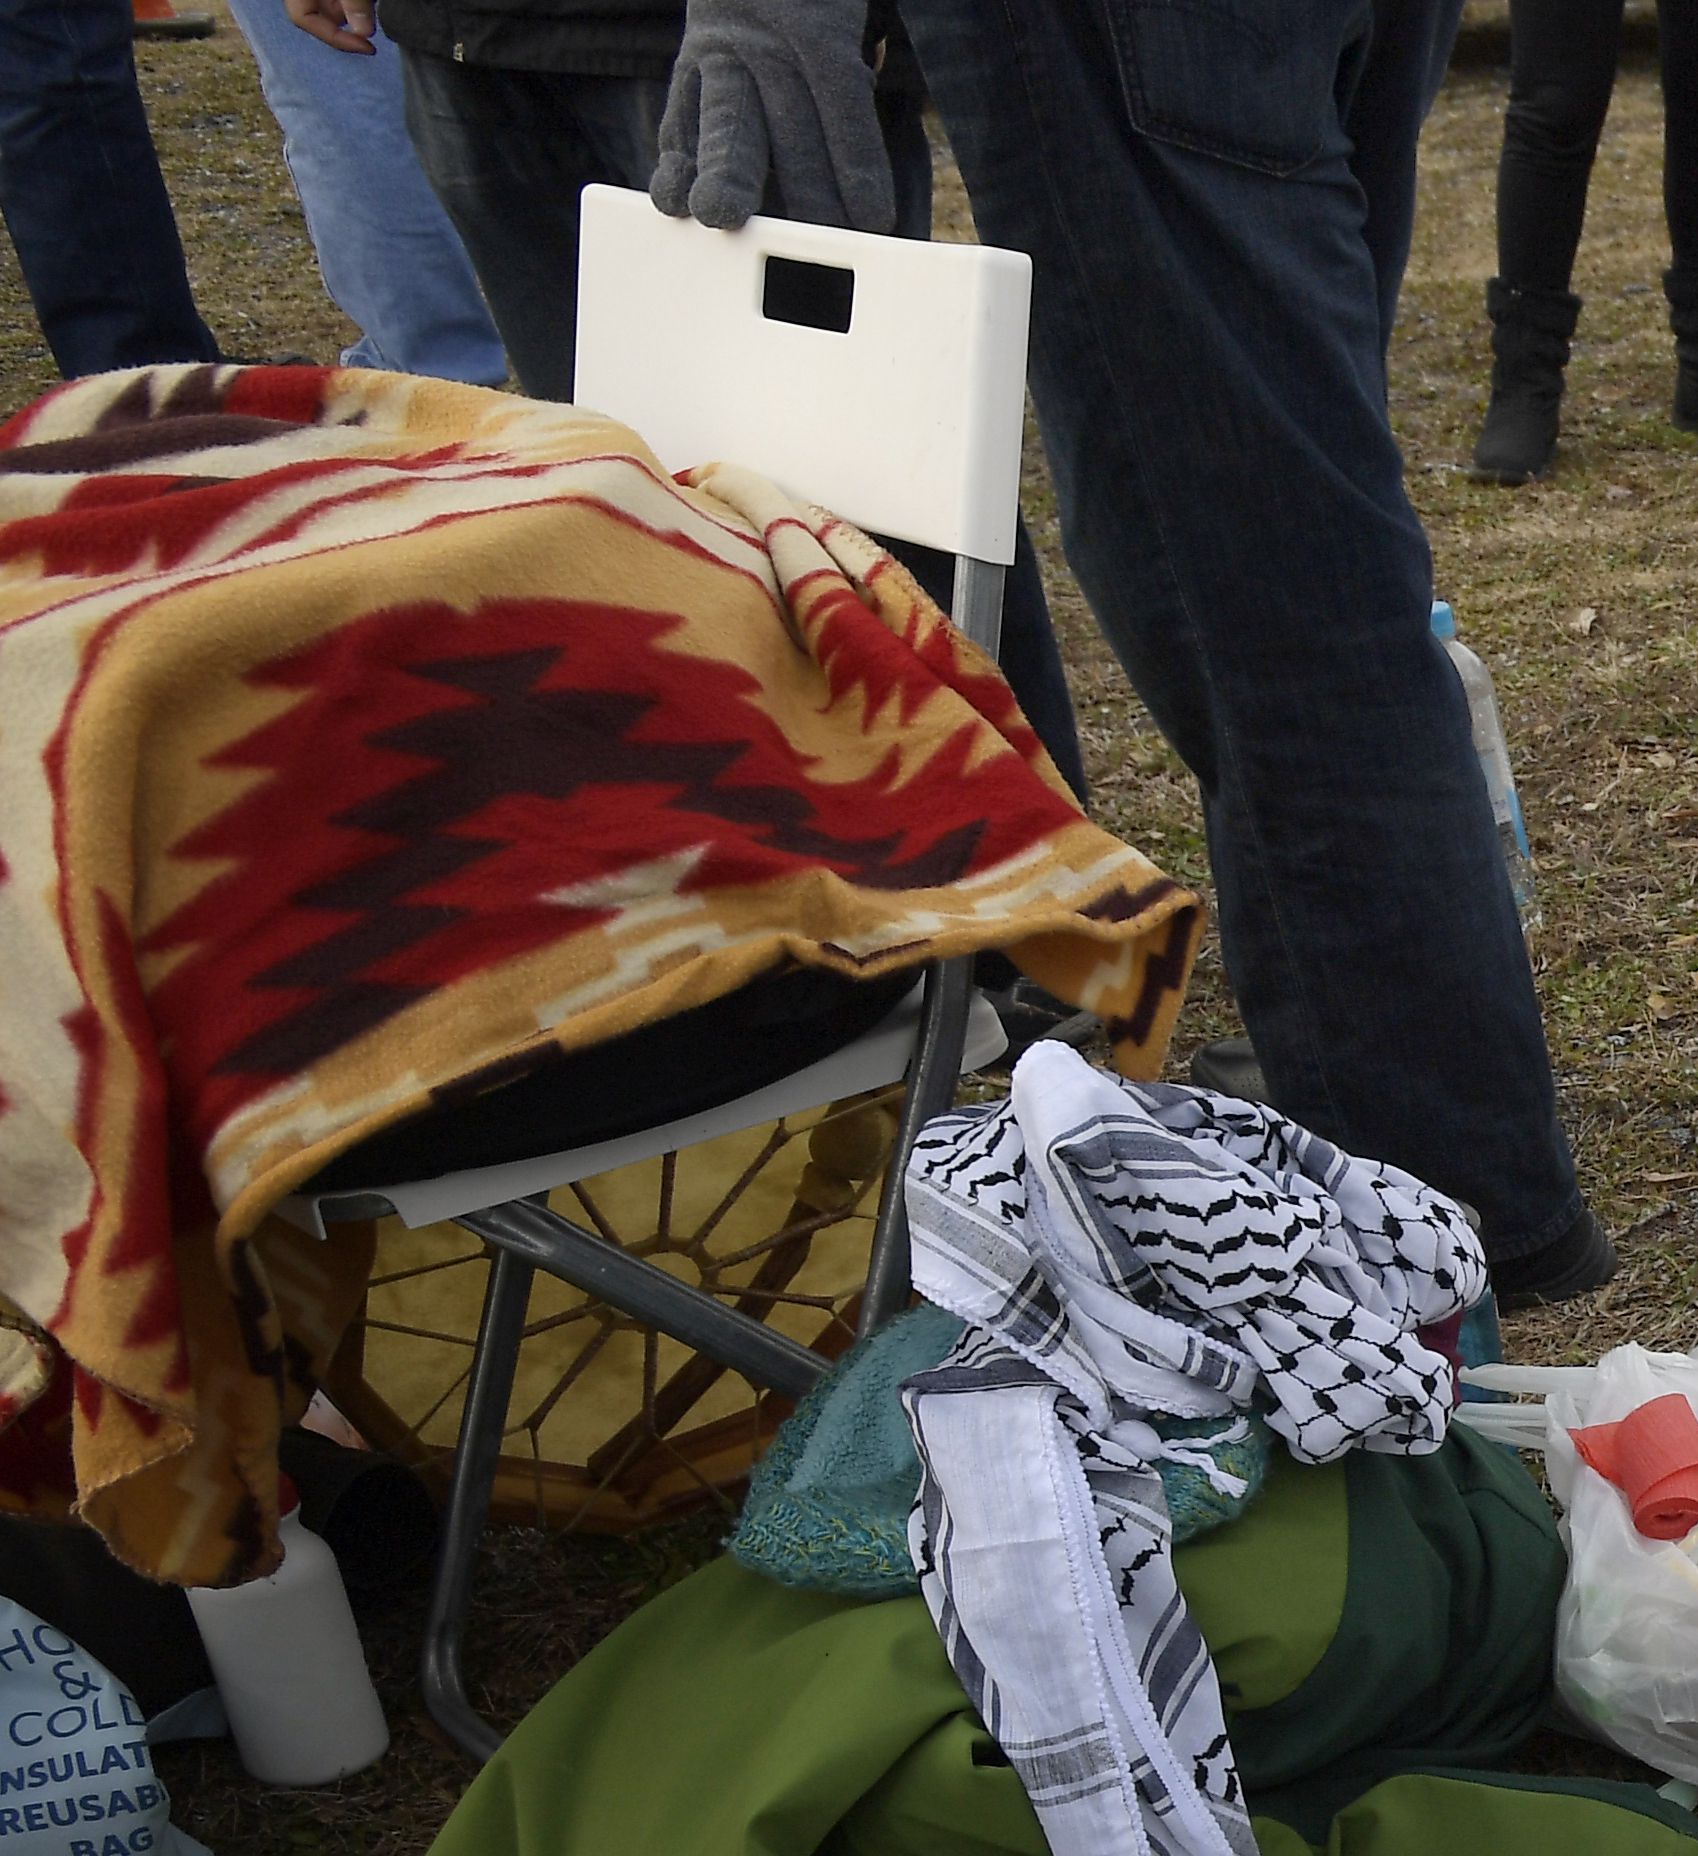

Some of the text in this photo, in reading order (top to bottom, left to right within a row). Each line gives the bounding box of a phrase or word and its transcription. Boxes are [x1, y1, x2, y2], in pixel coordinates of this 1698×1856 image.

[0, 1624, 75, 1672] HO
[52, 1660, 103, 1700] &
[0, 1740, 148, 1796] NSULAT
[0, 1783, 166, 1836] REUSAB
